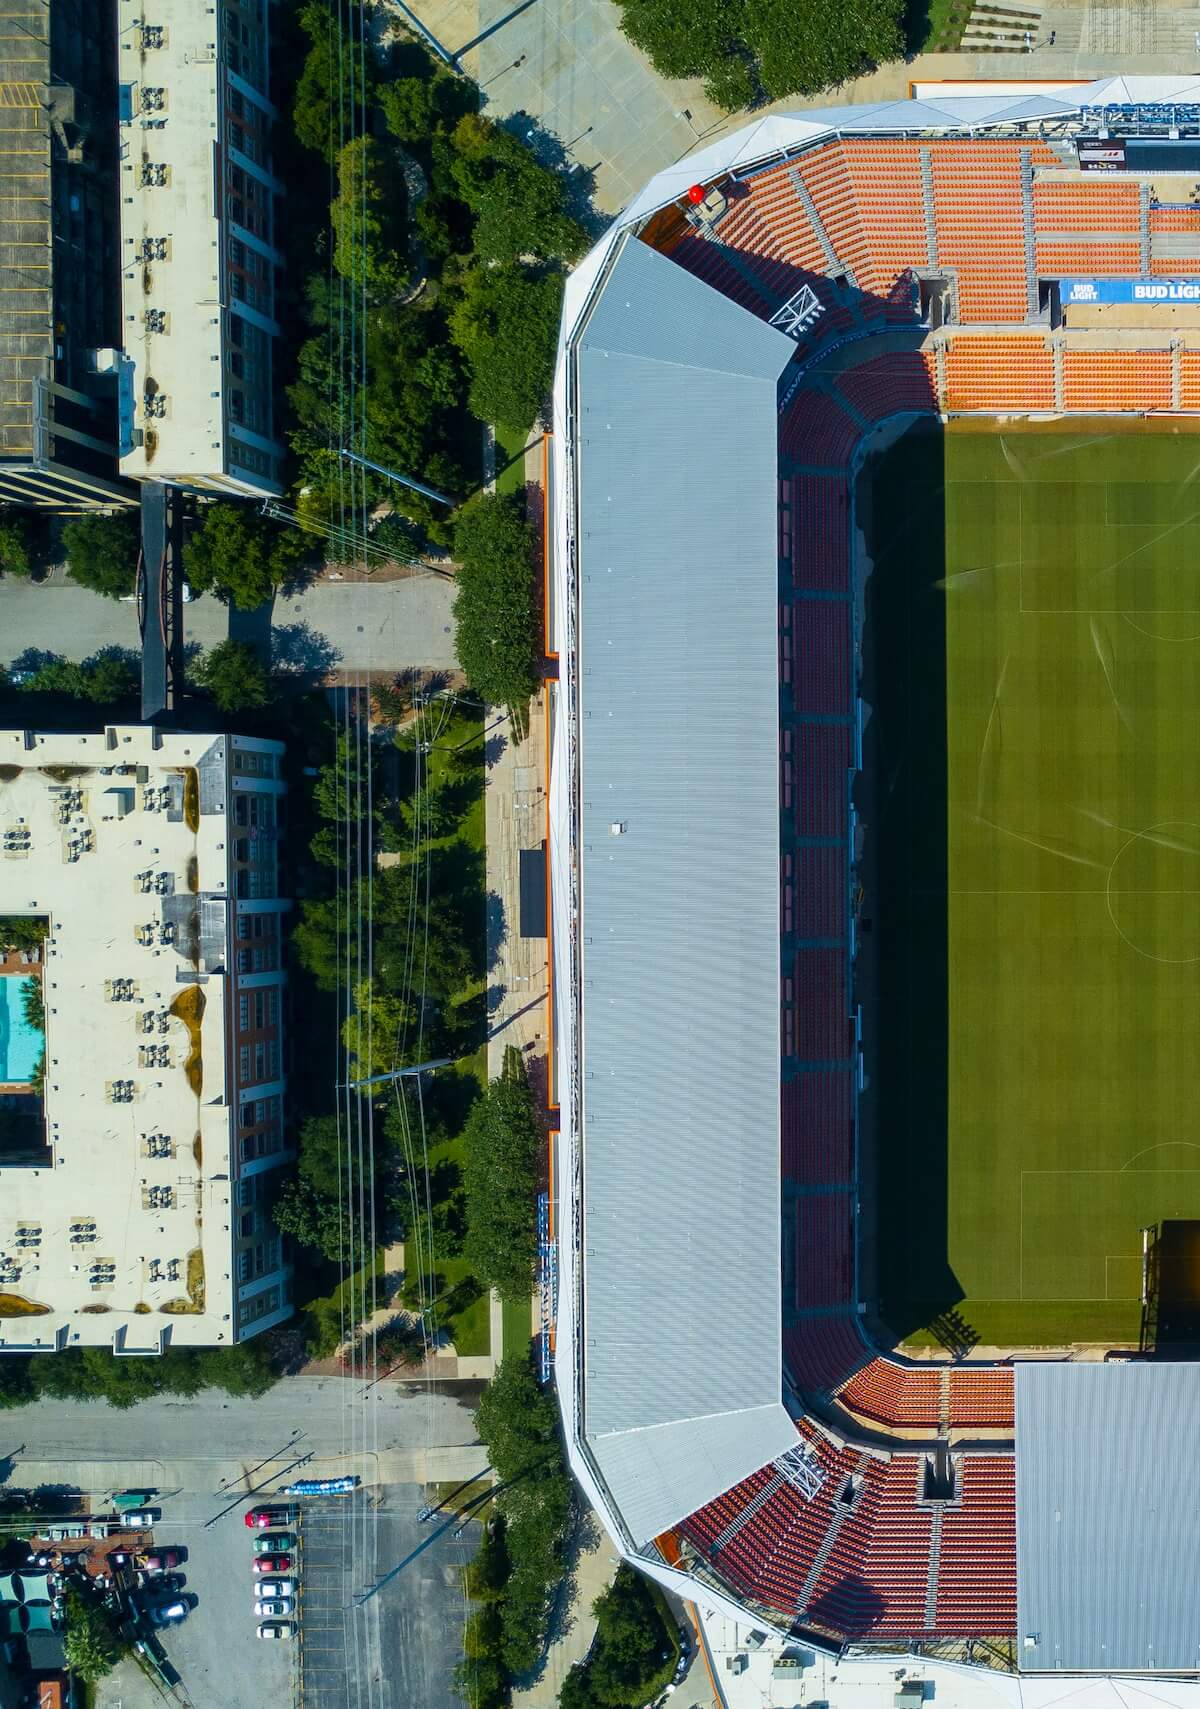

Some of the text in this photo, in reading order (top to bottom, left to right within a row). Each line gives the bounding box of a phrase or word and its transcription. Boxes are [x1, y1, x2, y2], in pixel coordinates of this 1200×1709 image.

[1073, 284, 1094, 292] BUD
[1135, 285, 1168, 299] BUD
[1070, 291, 1098, 300] LIGHT
